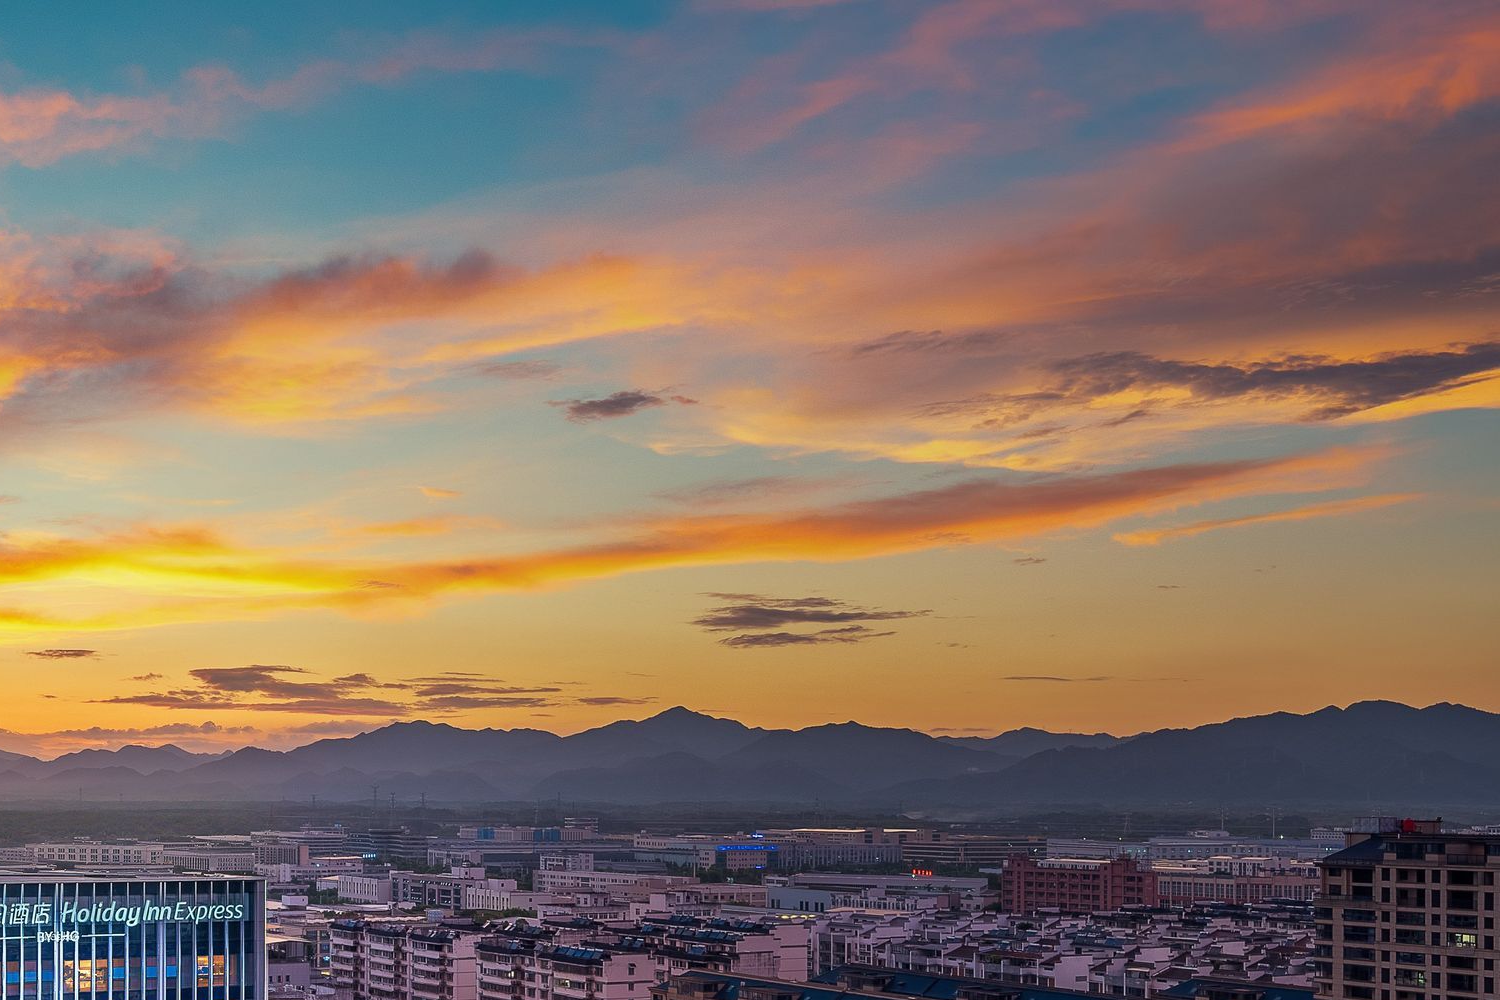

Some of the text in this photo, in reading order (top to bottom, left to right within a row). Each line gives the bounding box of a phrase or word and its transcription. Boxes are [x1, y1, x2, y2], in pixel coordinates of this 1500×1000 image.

[60, 900, 244, 927] Holiday Inn Express
